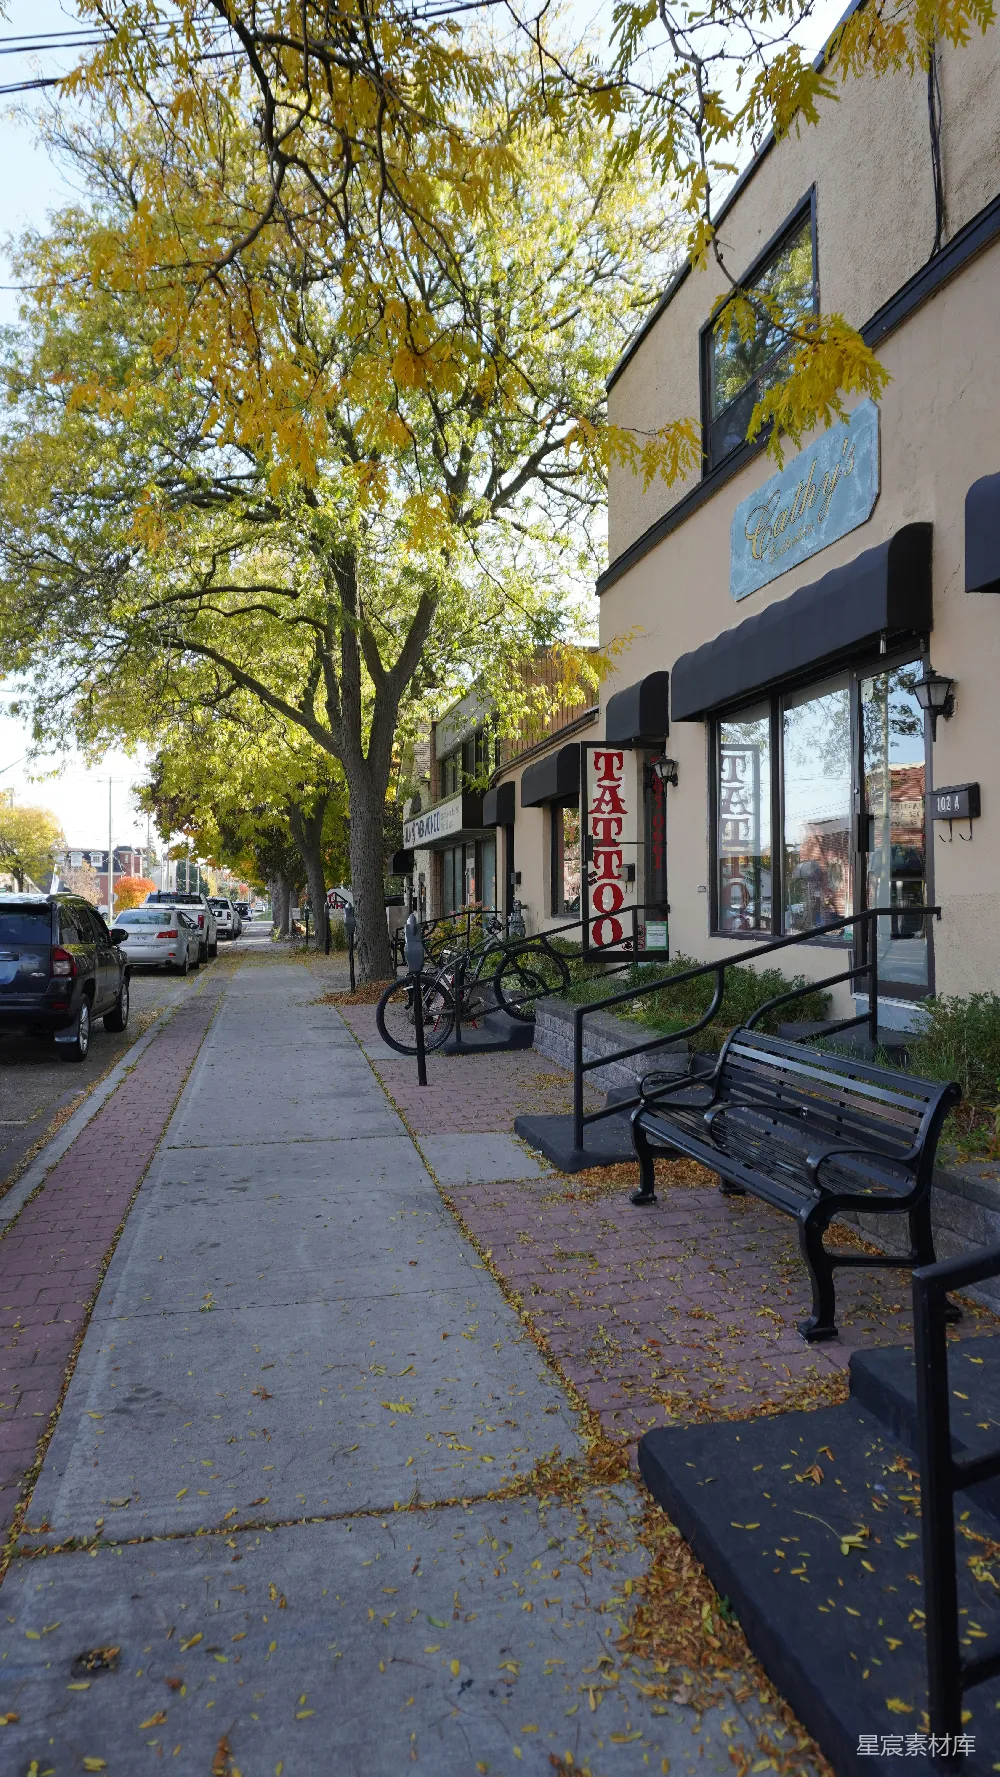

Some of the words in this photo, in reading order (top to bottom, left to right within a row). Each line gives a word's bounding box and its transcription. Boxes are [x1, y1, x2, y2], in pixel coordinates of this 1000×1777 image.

[744, 437, 856, 560] Cathy's
[588, 751, 628, 947] TATTOO
[937, 796, 952, 812] 102
[954, 795, 960, 812] A
